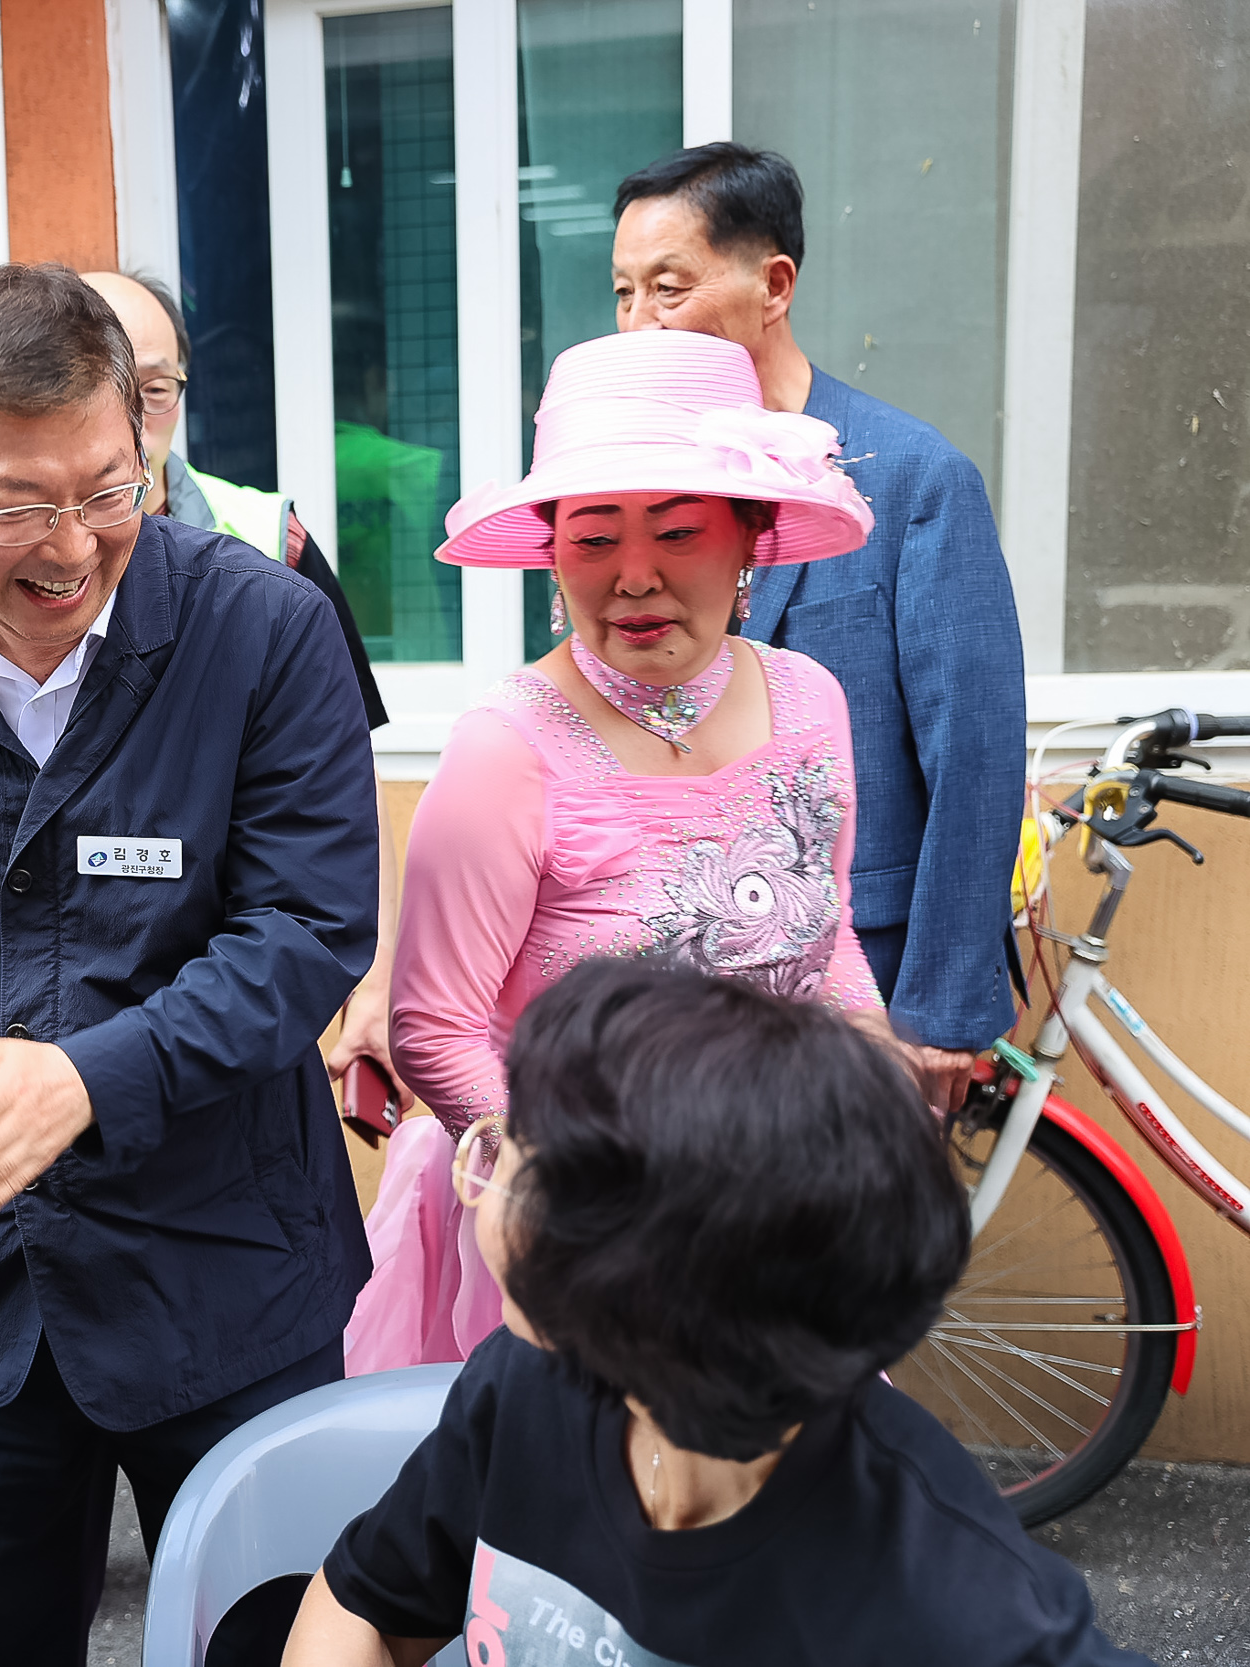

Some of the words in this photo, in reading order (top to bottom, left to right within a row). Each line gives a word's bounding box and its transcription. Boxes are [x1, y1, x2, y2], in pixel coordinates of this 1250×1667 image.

[113, 847, 172, 863] 김경호
[120, 864, 165, 876] 광진구청장
[528, 1595, 586, 1649] The
[594, 1635, 632, 1667] Cl
